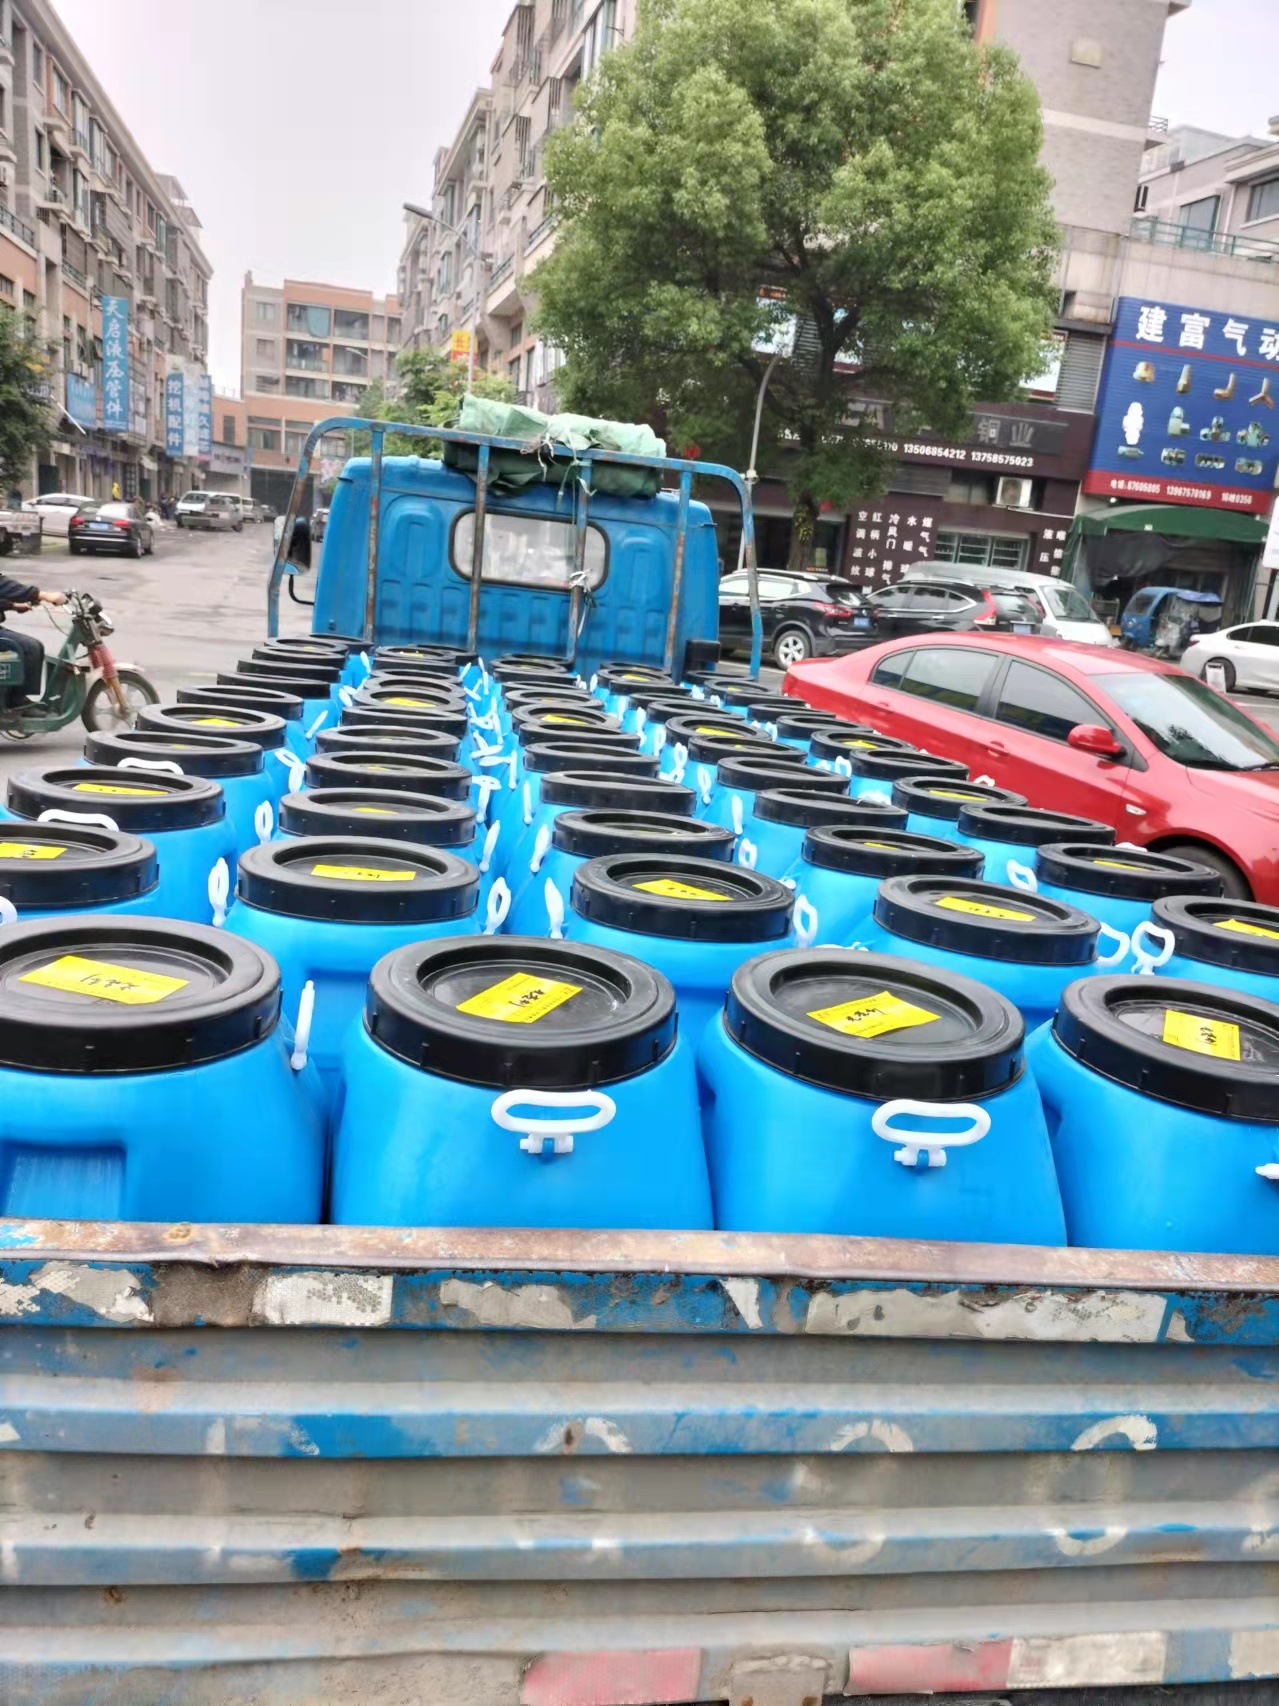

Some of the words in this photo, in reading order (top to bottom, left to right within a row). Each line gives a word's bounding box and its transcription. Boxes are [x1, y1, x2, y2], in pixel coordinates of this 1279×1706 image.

[1136, 306, 1279, 361] 建富气动
[978, 418, 1033, 447] 铜业
[904, 443, 966, 459] 13506854212
[971, 451, 1033, 467] 13758575023
